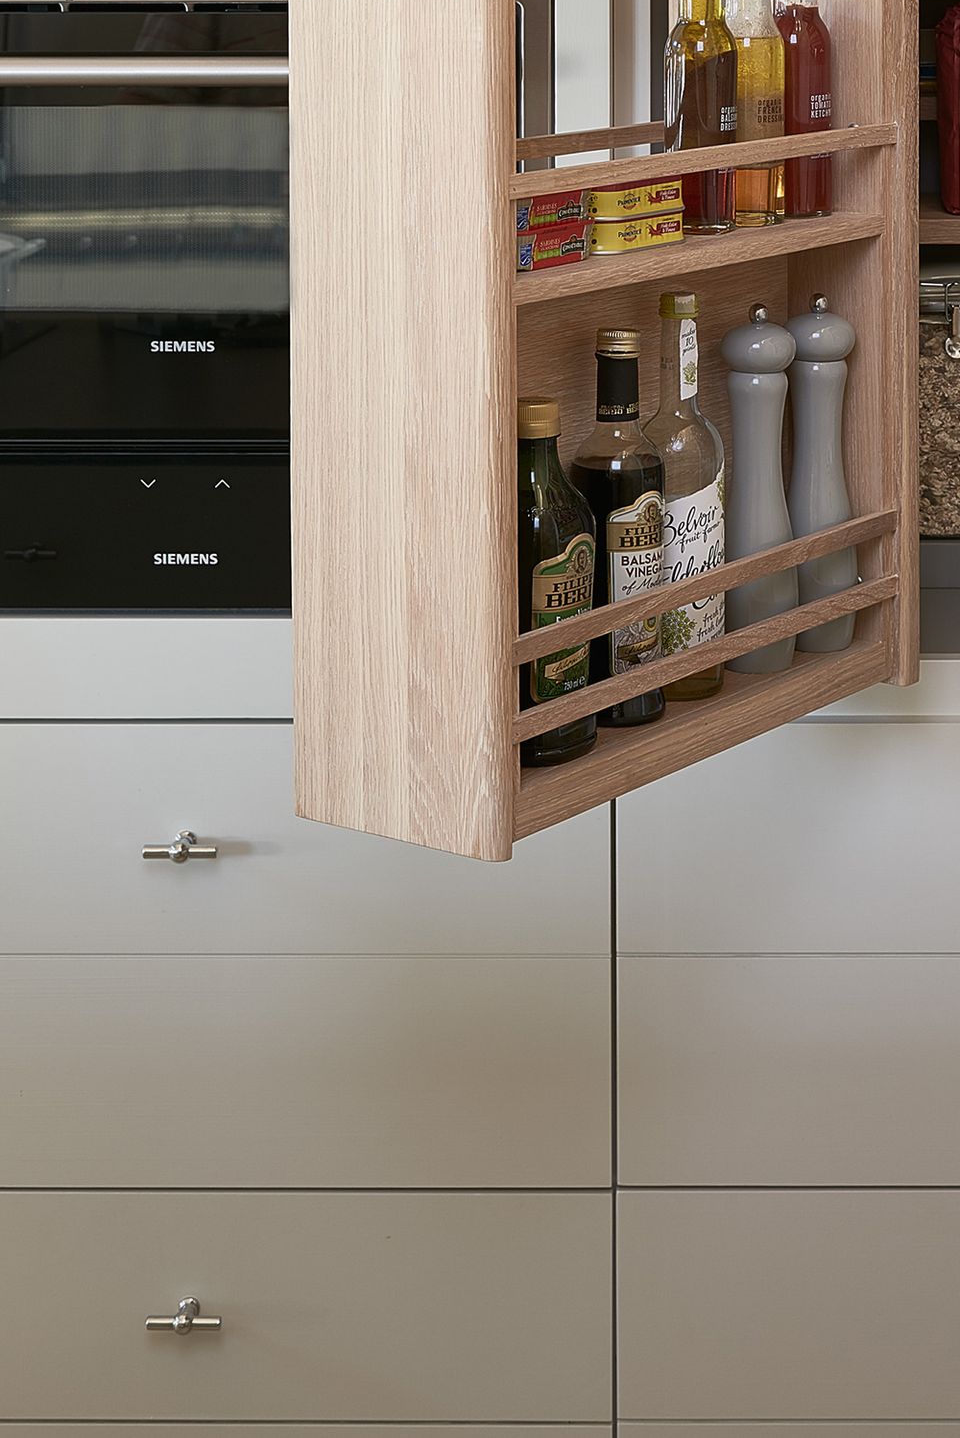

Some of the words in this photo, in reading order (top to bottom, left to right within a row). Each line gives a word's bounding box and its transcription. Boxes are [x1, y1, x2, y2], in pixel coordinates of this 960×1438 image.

[757, 106, 782, 115] FRENCH
[150, 340, 216, 352] SIEMENS
[685, 336, 694, 347] 10
[663, 505, 719, 548] Belvoir
[675, 530, 703, 554] fruit
[153, 553, 219, 565] SIEMENS
[621, 583, 638, 596] of
